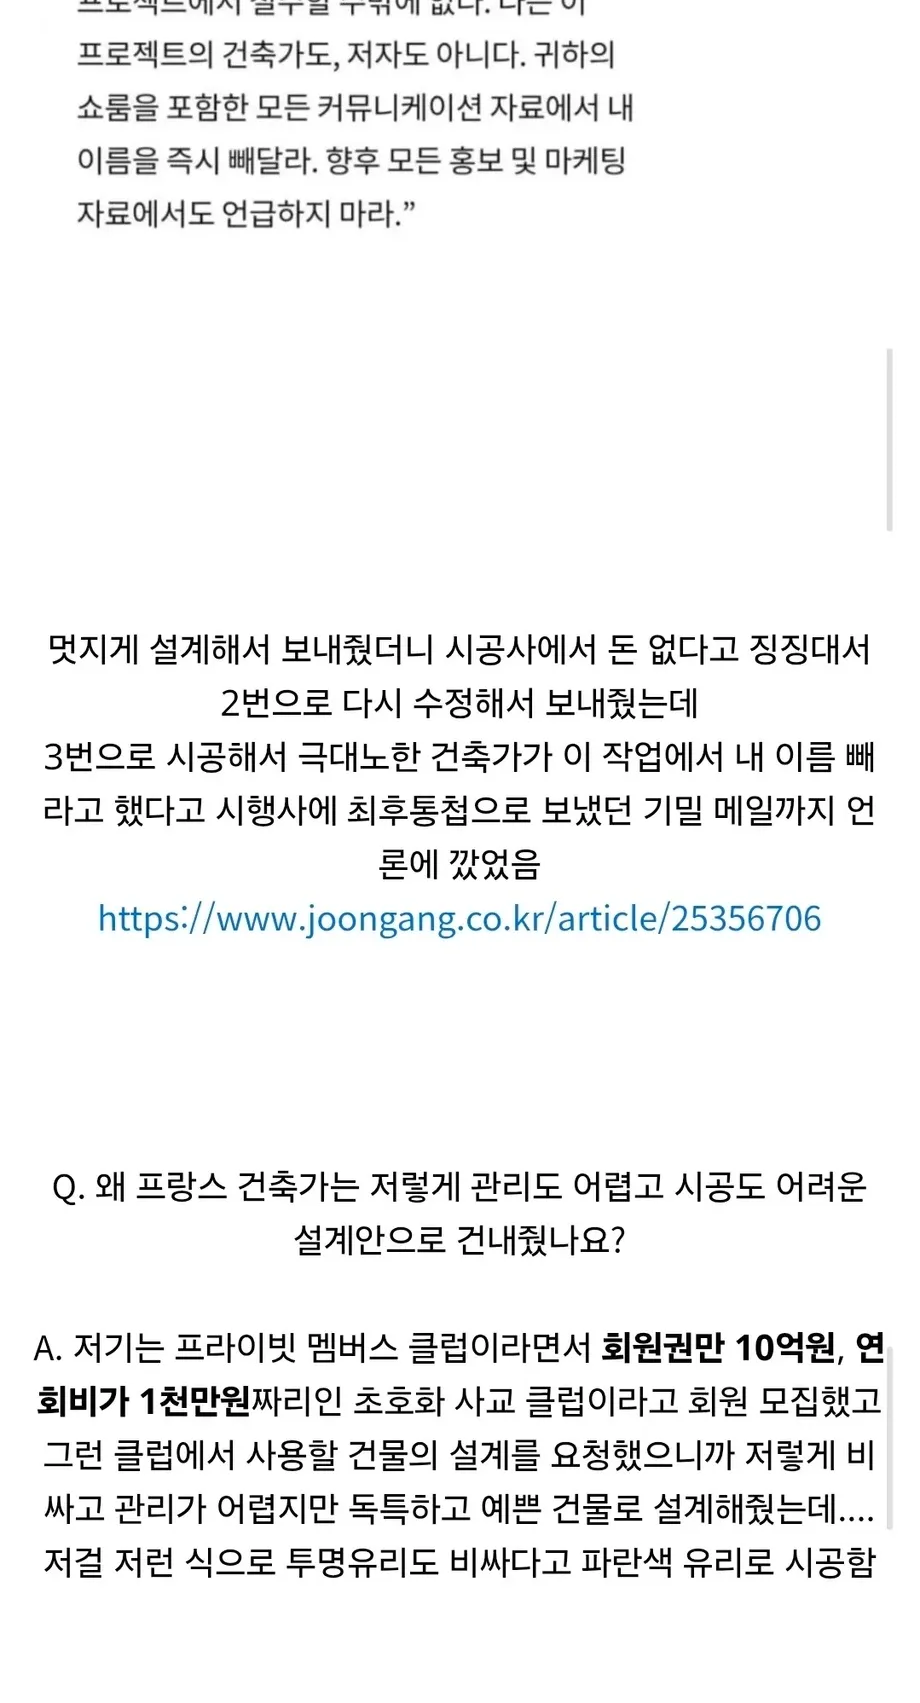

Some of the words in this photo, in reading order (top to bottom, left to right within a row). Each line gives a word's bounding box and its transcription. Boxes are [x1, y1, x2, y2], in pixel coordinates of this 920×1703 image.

[77, 39, 213, 70] 프로젝트의
[222, 39, 340, 73] 건축가도,
[347, 39, 430, 70] 저자도
[436, 39, 526, 70] 아니다.
[533, 39, 614, 70] 귀하의
[77, 93, 160, 123] 쇼룸을
[166, 92, 250, 123] 포함한
[255, 93, 311, 122] 모든
[317, 92, 482, 123] 커뮤니케이션
[490, 92, 599, 123] 자료에서
[608, 93, 633, 123] 내
[78, 145, 160, 176] 이름을
[166, 145, 219, 176] 즉시
[228, 145, 318, 176] 빼달라.
[325, 145, 381, 176] 향후
[387, 146, 442, 175] 모든
[449, 145, 504, 176] 홍보
[511, 145, 537, 176] 및
[545, 145, 625, 176] 마케팅
[77, 198, 216, 229] 자료에서도
[222, 198, 330, 229] 언급하지
[340, 198, 416, 229] 마라.”
[49, 633, 138, 666] 멋지게
[149, 633, 269, 666] 설계해서
[281, 633, 433, 667] 보내줬더니
[445, 633, 596, 667] 시공사에서
[607, 634, 638, 666] 돈
[648, 633, 740, 666] 없다고
[749, 633, 869, 666] 징징대서
[221, 687, 333, 719] 2번으로
[343, 687, 401, 720] 다시
[413, 687, 533, 720] 수정해서
[545, 687, 697, 720] 보내줬는데
[44, 741, 156, 773] 3번으로
[166, 740, 286, 774] 시공해서
[298, 741, 422, 774] 극대노한
[431, 740, 554, 774] 건축가가
[563, 741, 590, 773] 이
[602, 740, 723, 773] 작업에서
[736, 741, 763, 773] 내
[775, 741, 836, 773] 이름
[846, 741, 874, 773] 빼
[44, 795, 104, 827] 라고
[114, 794, 206, 828] 했다고
[215, 794, 337, 828] 시행사에
[347, 794, 532, 828] 최후통첩으로
[541, 794, 631, 827] 보냈던
[643, 794, 702, 827] 기밀
[714, 794, 834, 827] 메일까지
[847, 795, 875, 826] 언
[378, 848, 438, 881] 론에
[449, 848, 541, 881] 깠었음
[99, 900, 821, 940] https://www.joongang.co.kr/article/25356706
[52, 1173, 85, 1206] Q.
[95, 1170, 125, 1203] 왜
[136, 1170, 228, 1203] 프랑스
[238, 1170, 360, 1204] 건축가는
[370, 1170, 460, 1204] 저렇게
[470, 1170, 563, 1203] 관리도
[573, 1170, 665, 1203] 어렵고
[674, 1170, 766, 1204] 시공도
[776, 1170, 867, 1203] 어려운
[293, 1224, 447, 1257] 설계안으로
[457, 1224, 626, 1258] 건내줬나요?
[33, 1334, 62, 1362] A.
[73, 1331, 165, 1364] 저기는
[174, 1332, 296, 1364] 프라이빗
[307, 1331, 399, 1364] 멤버스
[408, 1331, 590, 1365] 클럽이라면서
[601, 1331, 726, 1365] 회원권만
[735, 1331, 844, 1366] 10억원,
[856, 1331, 885, 1364] 연
[43, 1546, 103, 1579] 저걸
[114, 1546, 173, 1579] 저런
[185, 1547, 277, 1579] 식으로
[285, 1546, 440, 1579] 투명유리도
[450, 1546, 572, 1579] 비싸다고
[581, 1546, 672, 1579] 파란색
[683, 1546, 775, 1579] 유리로
[785, 1546, 877, 1580] 시공함
